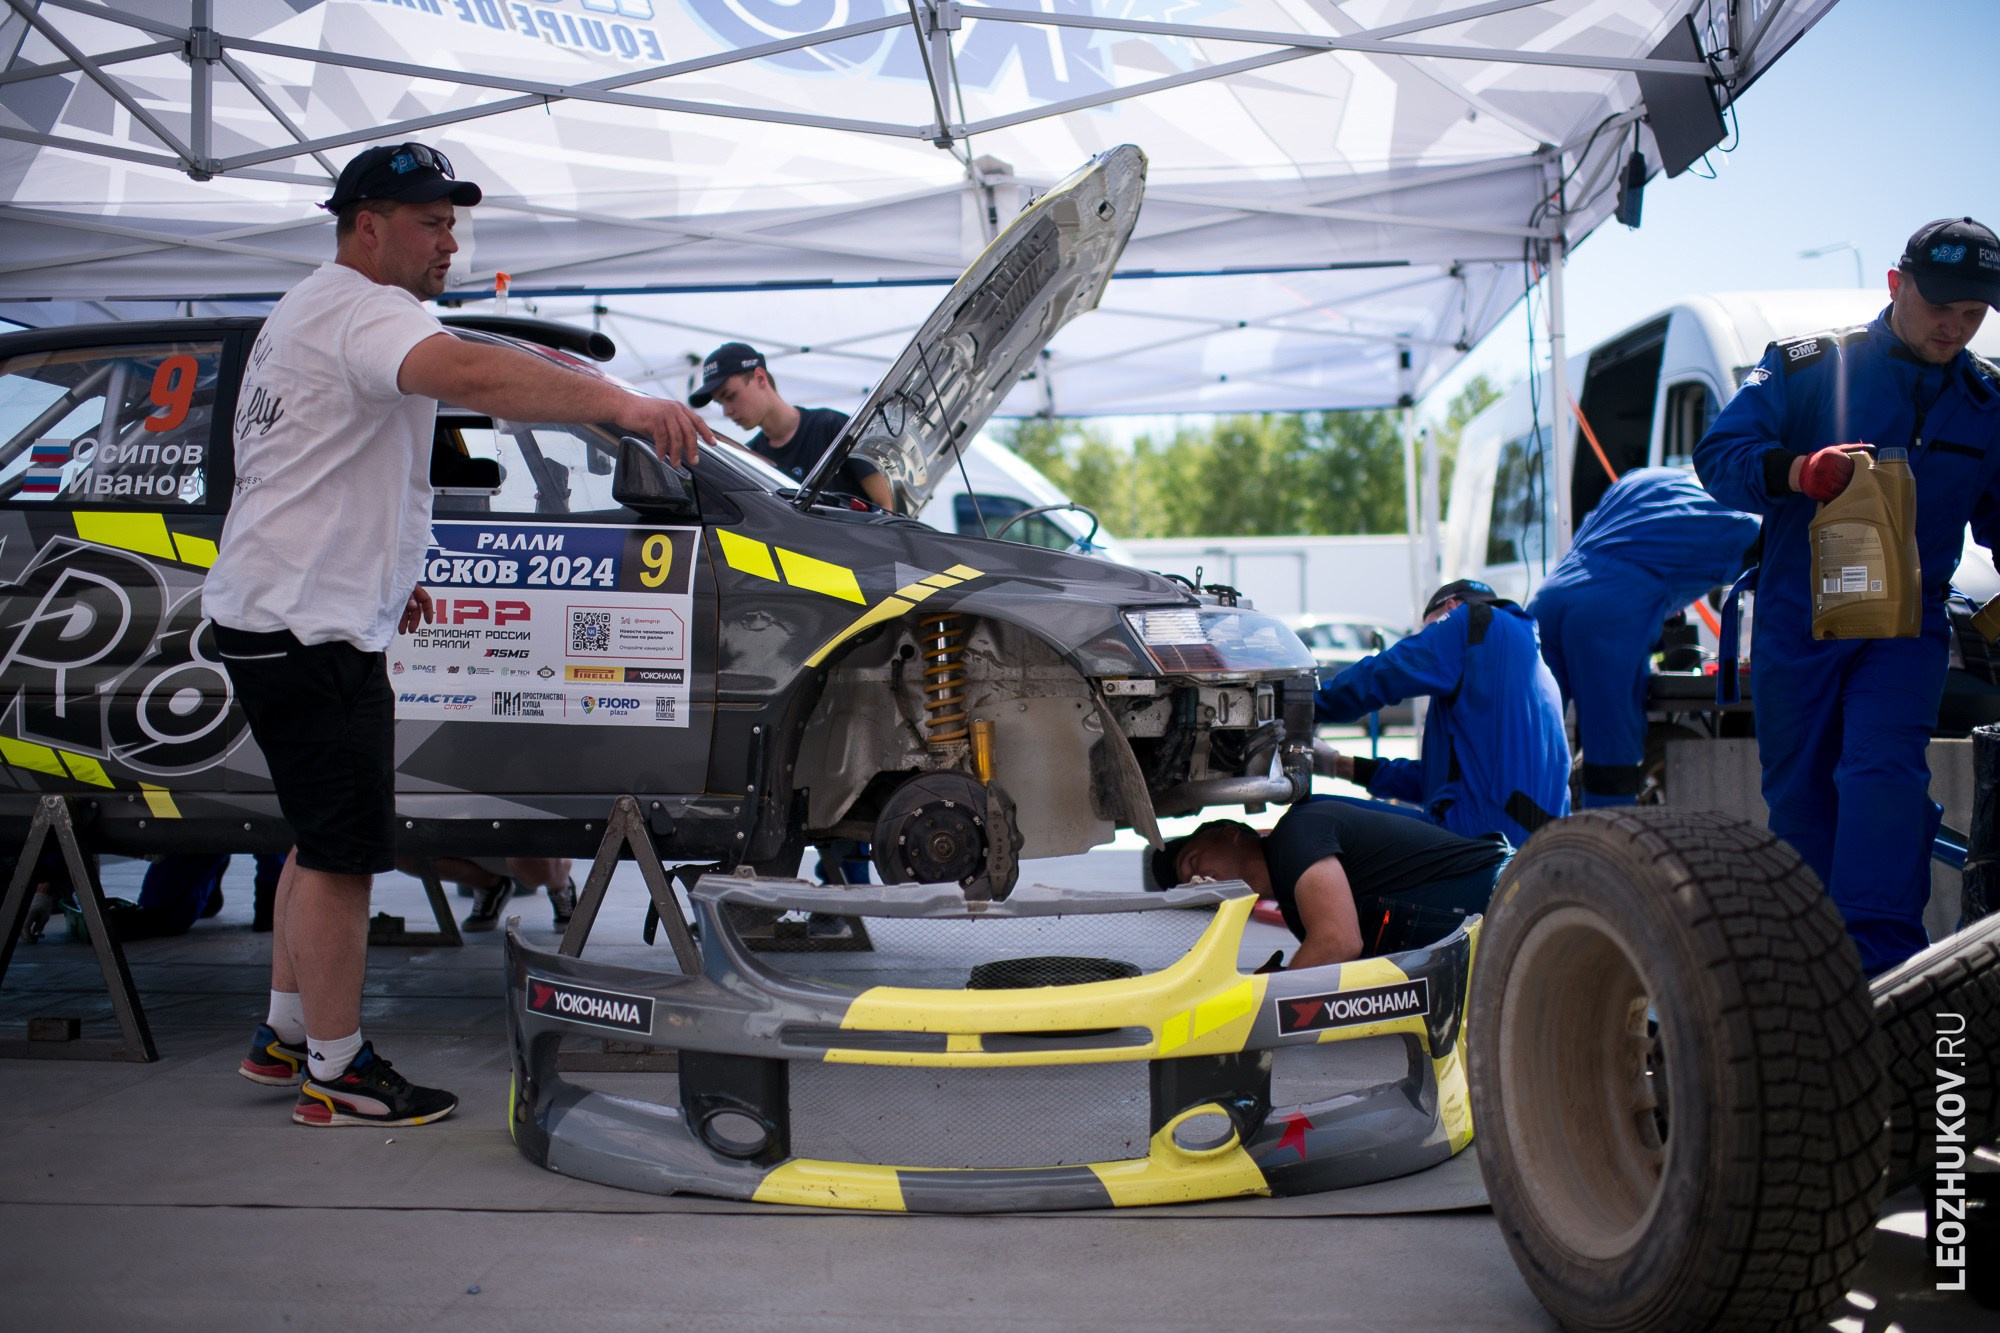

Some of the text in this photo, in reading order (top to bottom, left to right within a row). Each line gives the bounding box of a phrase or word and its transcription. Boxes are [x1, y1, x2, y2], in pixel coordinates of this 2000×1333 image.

[1937, 247, 1964, 261] R8
[1789, 343, 1818, 359] OMP
[144, 355, 198, 432] 9
[72, 437, 204, 465] Осипов
[68, 467, 198, 497] Иванов
[477, 533, 565, 551] РАЛЛИ
[639, 534, 673, 588] 9
[526, 556, 614, 587] 2024
[414, 629, 531, 640] ЧЕМПИОНАТ РОССИИ
[413, 639, 470, 649] ПО РАЛЛИ
[490, 649, 530, 658] ASMG
[573, 668, 614, 679] PIRELLI
[640, 672, 682, 680] YOKOHAMA
[399, 693, 477, 704] МАСТЕР
[522, 692, 564, 701] ПРОСТРАНСТВО
[598, 697, 640, 709] FJORD
[522, 701, 541, 709] КУПЦА
[656, 699, 675, 712] КВАС
[522, 708, 544, 717] ЛАПИНА
[555, 991, 641, 1024] YOKOHAMA
[1324, 989, 1420, 1020] YOKOHAMA
